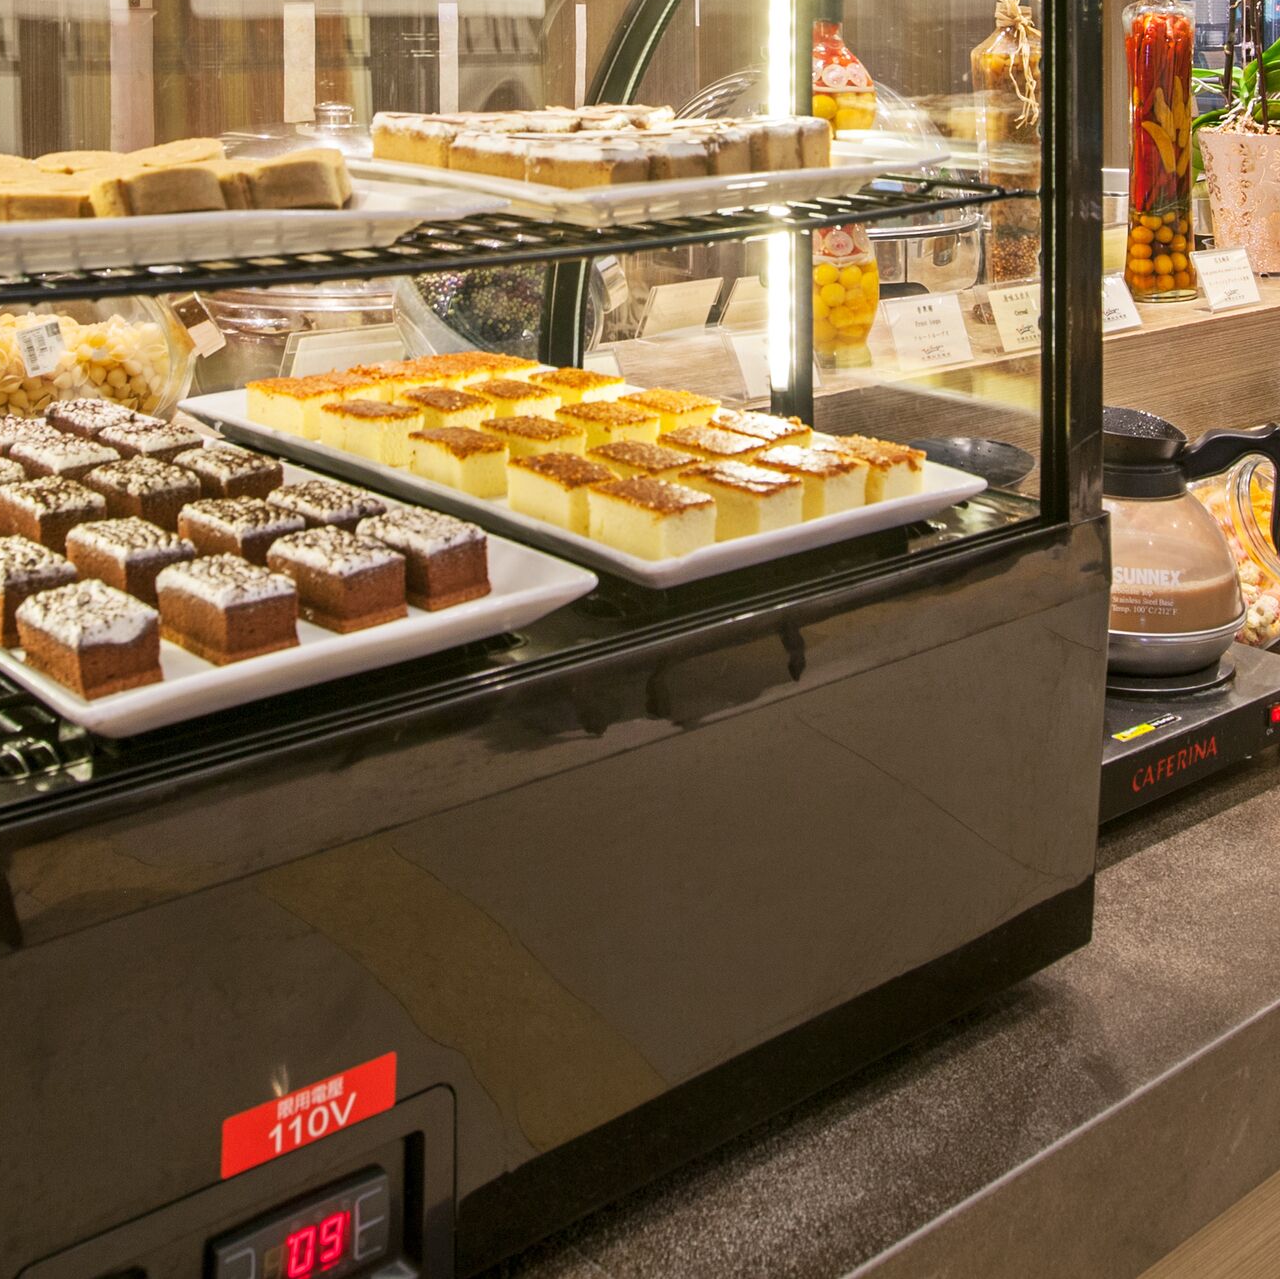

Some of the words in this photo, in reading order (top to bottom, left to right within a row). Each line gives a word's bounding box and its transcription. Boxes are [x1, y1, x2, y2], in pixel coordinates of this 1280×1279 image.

[1112, 566, 1181, 586] SUNNEX
[1131, 736, 1218, 793] CAFERINA
[268, 1092, 357, 1154] 110V
[276, 1075, 345, 1121] 限用電壓
